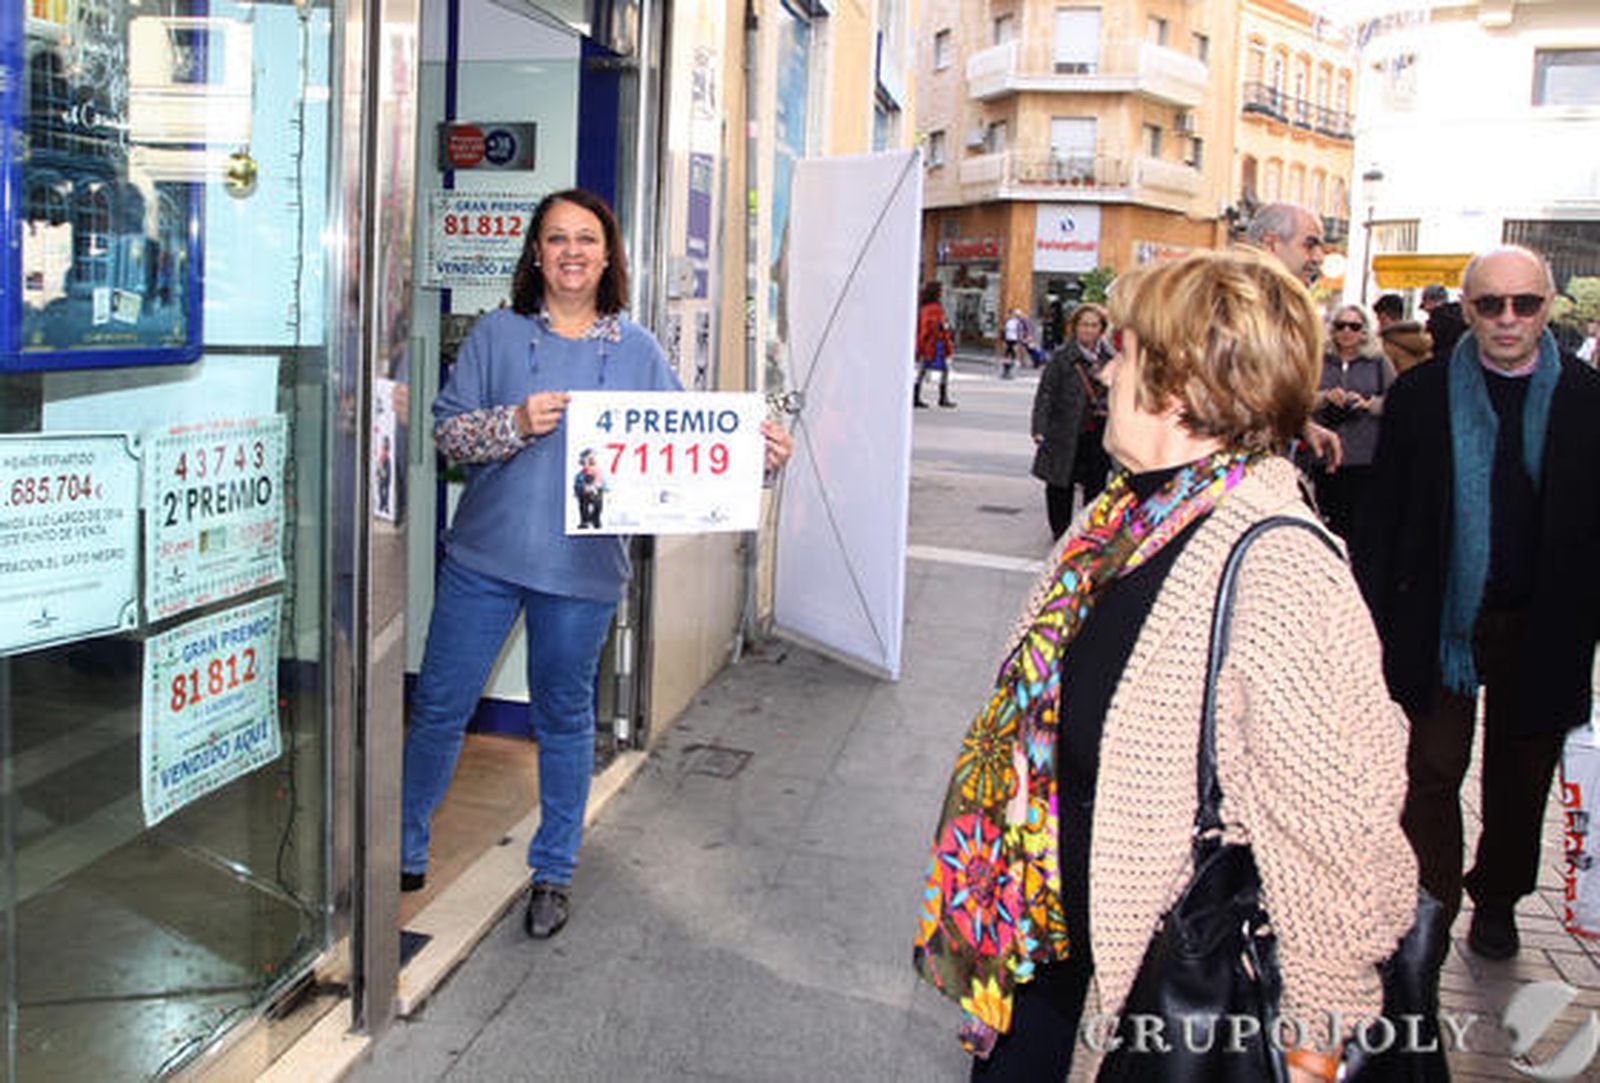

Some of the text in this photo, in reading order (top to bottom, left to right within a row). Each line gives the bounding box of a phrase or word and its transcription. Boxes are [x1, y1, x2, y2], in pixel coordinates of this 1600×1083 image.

[456, 201, 488, 213] GRAN
[436, 260, 498, 276] VENDIDO
[625, 409, 740, 434] PREMIO
[605, 442, 731, 475] 71119
[186, 476, 273, 522] PREMIO
[182, 635, 218, 663] GRAN
[222, 616, 270, 650] PREMIO
[160, 740, 230, 790] VENDIDO
